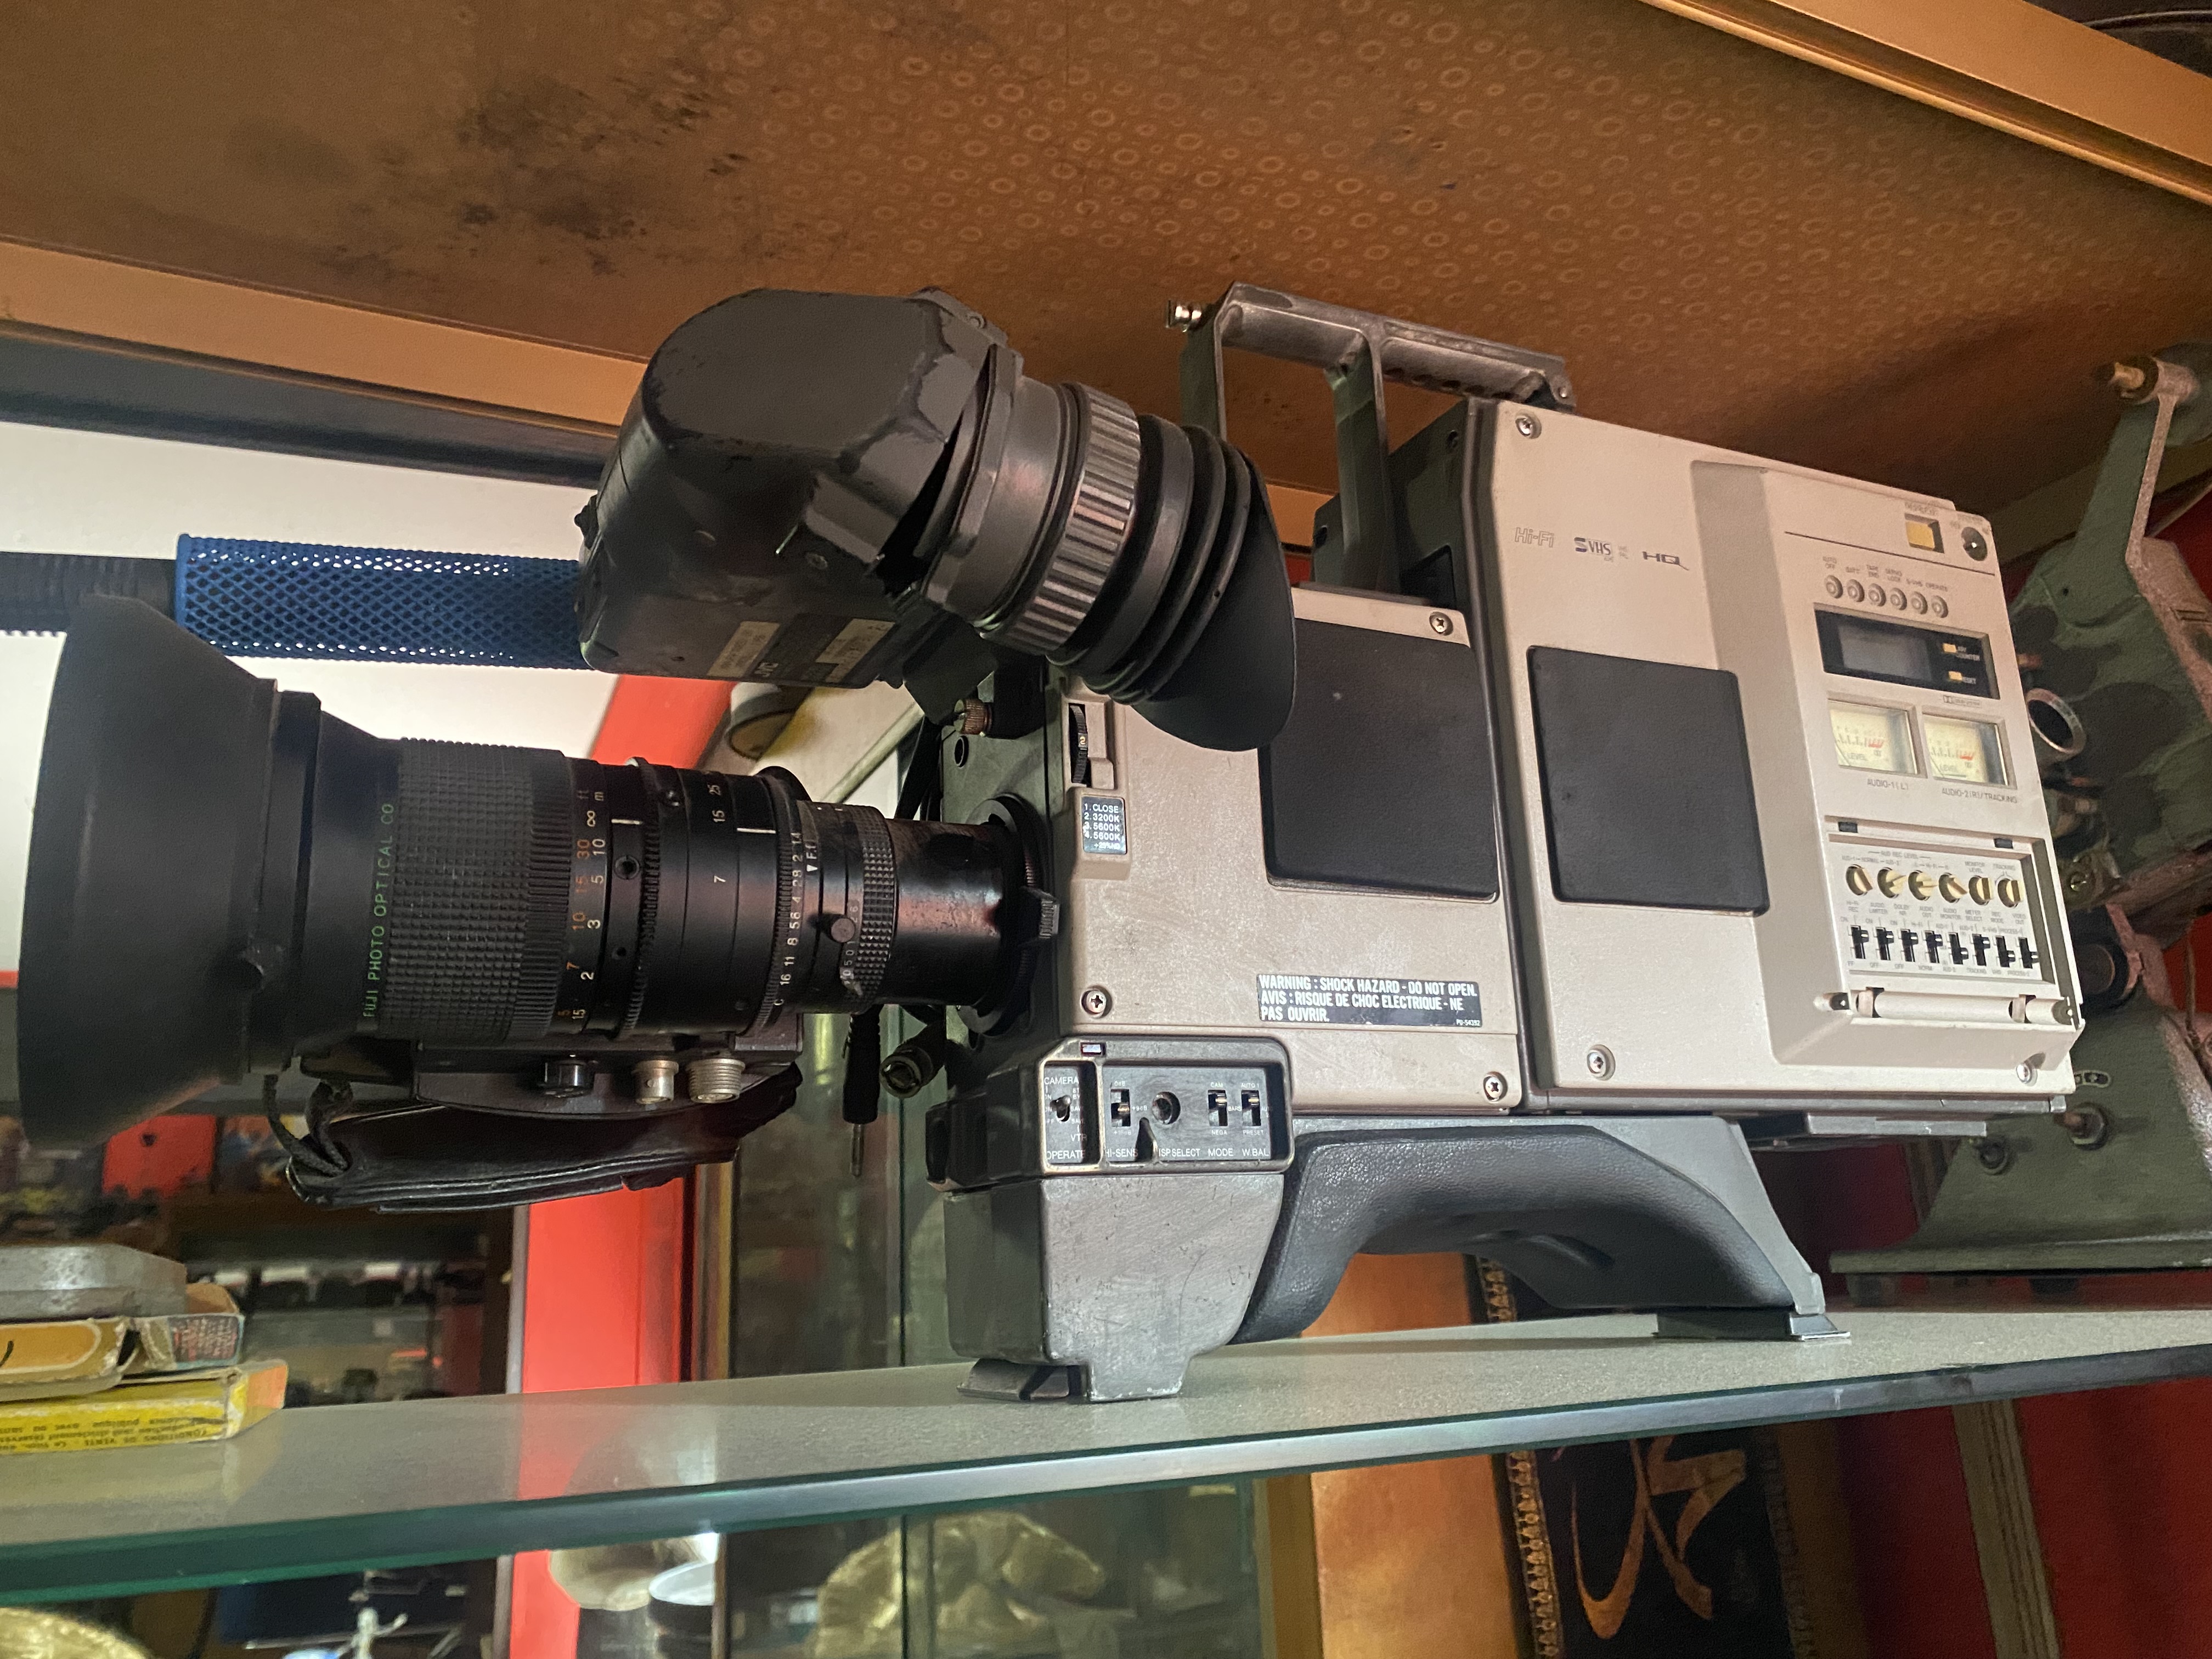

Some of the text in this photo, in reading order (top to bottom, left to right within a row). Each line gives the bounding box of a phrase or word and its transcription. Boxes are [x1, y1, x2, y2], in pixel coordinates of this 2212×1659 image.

[1514, 527, 1554, 548] Hi-Fi
[1642, 551, 1689, 571] HQ
[712, 810, 726, 823] 15
[577, 838, 590, 860] 30
[592, 838, 606, 856] 10
[792, 854, 803, 862] 2
[591, 875, 604, 885] 5
[714, 875, 726, 883] 7
[363, 804, 394, 1017] FUJI PHOTO OPTICAL CO
[572, 912, 586, 931] 10
[587, 919, 601, 929] 3
[787, 937, 799, 946] 8
[785, 956, 795, 966] 11
[580, 972, 595, 980] 2
[780, 973, 791, 985] 16
[1259, 974, 1311, 991] WARNING
[1319, 977, 1355, 992] SHOCK
[1357, 979, 1400, 994] HAZARD
[1408, 981, 1423, 995] DO
[1425, 981, 1445, 996] NOT
[1448, 983, 1478, 997] OPEN.
[1261, 990, 1287, 1005] AVIS
[1295, 991, 1334, 1007] RISQUE
[1335, 993, 1350, 1007] DE
[1351, 994, 1380, 1008] CHOC
[1381, 995, 1443, 1011] ELECTRIQUE
[1449, 997, 1464, 1011] NE
[1261, 1006, 1330, 1022] PAS OUVRIR.
[1044, 1076, 1079, 1085] CAMERA
[1071, 1133, 1087, 1142] VTR
[1158, 1148, 1200, 1158] ISP SELECT
[1208, 1148, 1234, 1157] MODE
